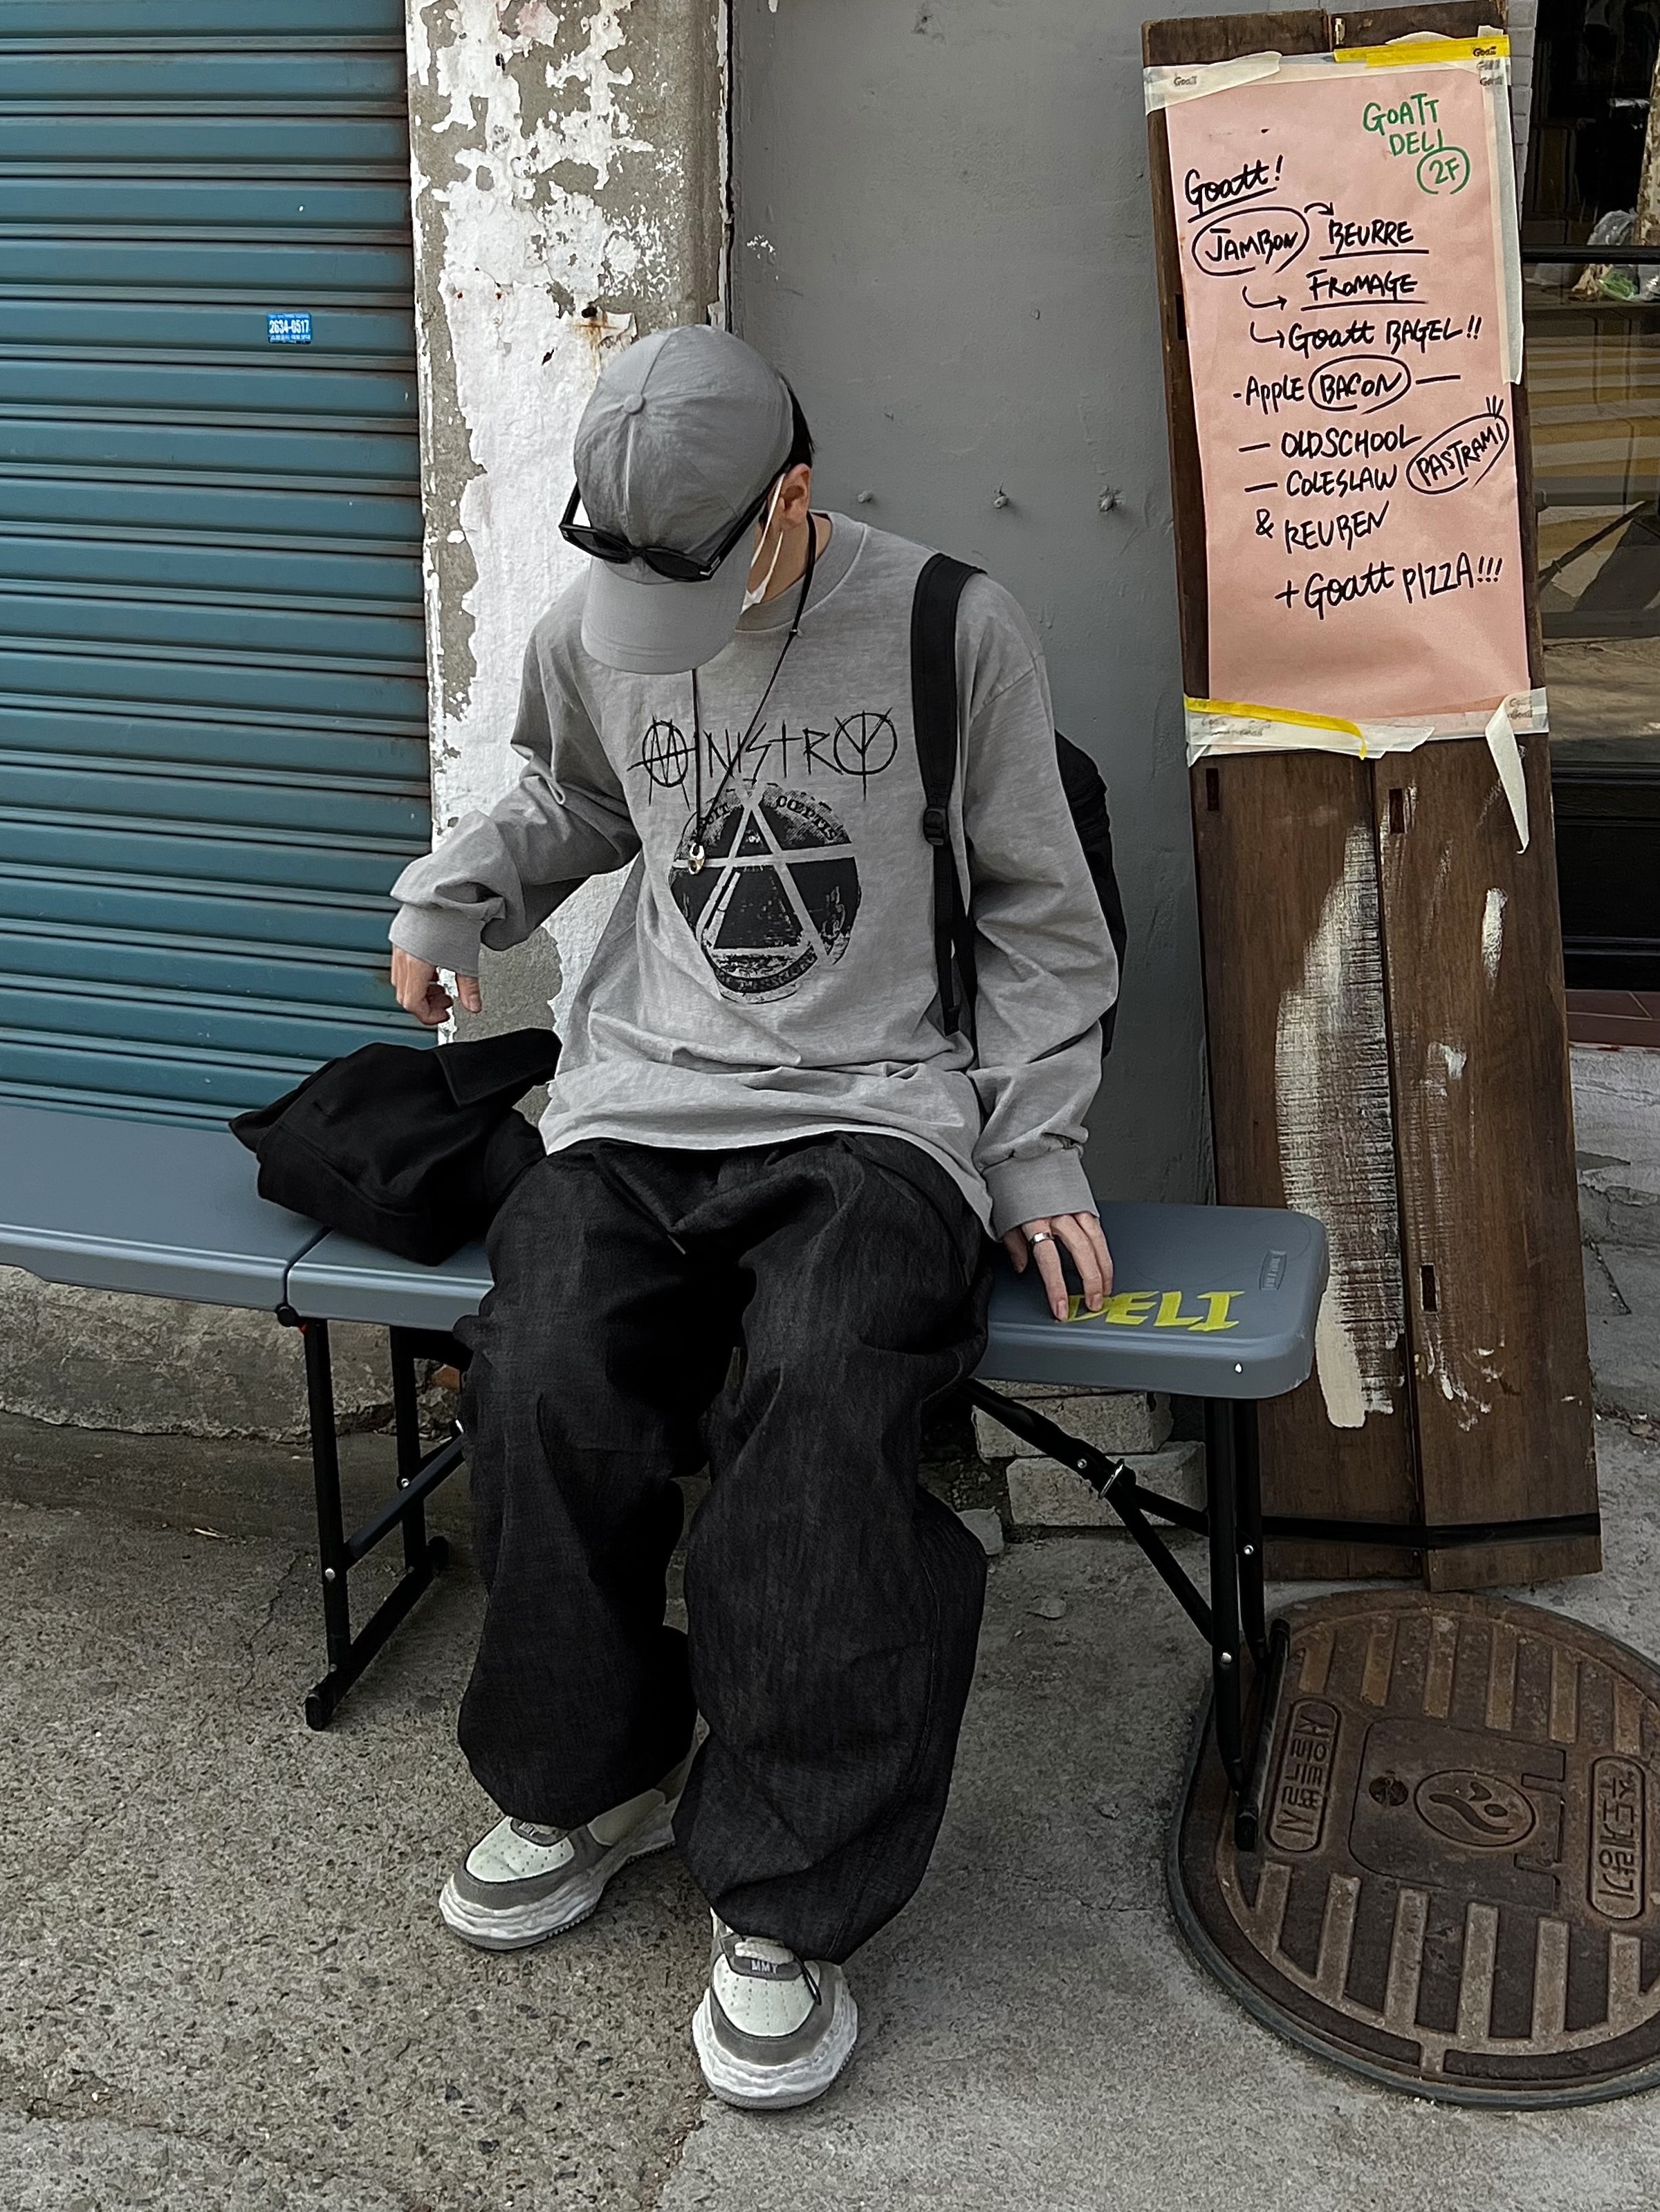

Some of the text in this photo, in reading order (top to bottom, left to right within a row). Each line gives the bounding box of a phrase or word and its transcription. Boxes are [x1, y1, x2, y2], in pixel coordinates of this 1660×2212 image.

[1389, 128, 1444, 156] DELI
[1429, 157, 1460, 184] 2F
[1205, 219, 1414, 264] JAMBON BEURRE
[1306, 269, 1418, 302] FROMAGE
[268, 319, 309, 334] 2634-0517
[1289, 320, 1374, 359] Goatt
[1320, 372, 1402, 404] BACON
[1416, 422, 1505, 487] PASTRAMI
[1286, 464, 1397, 497] COLESLAW
[1256, 500, 1390, 554] & REUBEN
[1276, 1714, 1333, 1836] 서울특별시
[1598, 1773, 1637, 1900] 수도계량기
[751, 1960, 778, 1974] MMY
